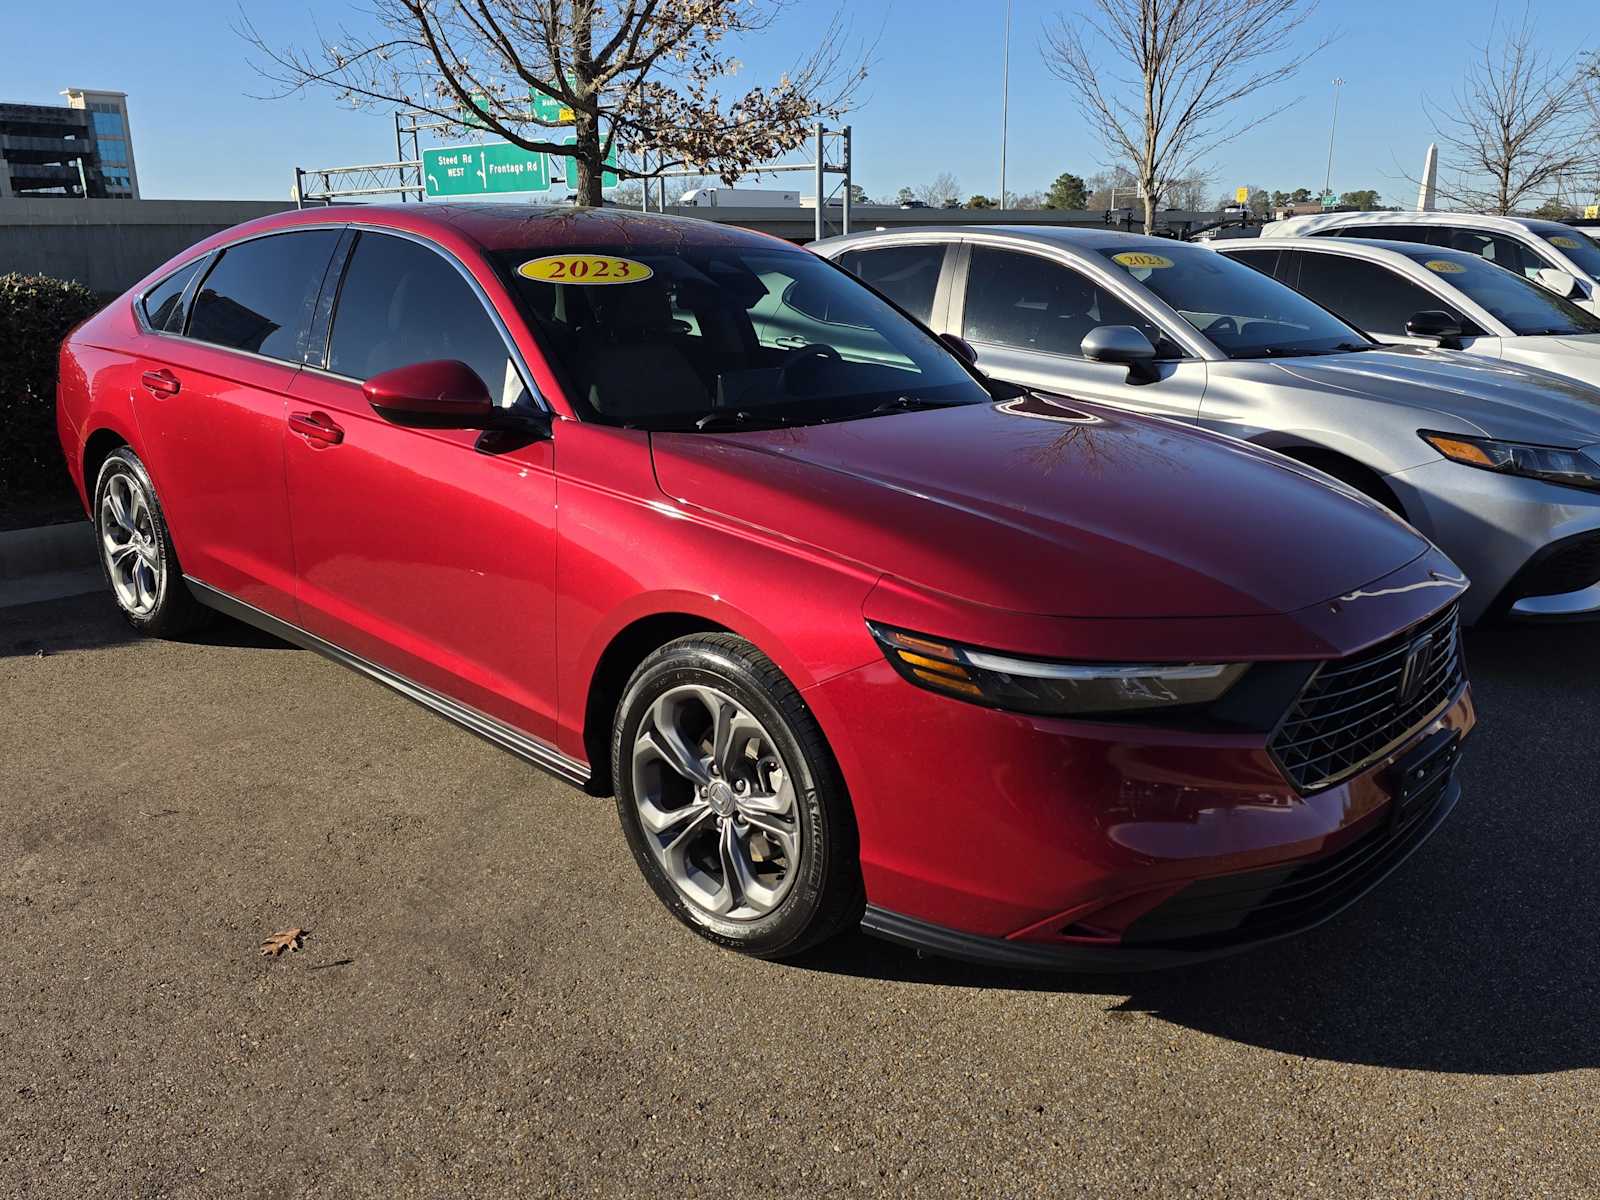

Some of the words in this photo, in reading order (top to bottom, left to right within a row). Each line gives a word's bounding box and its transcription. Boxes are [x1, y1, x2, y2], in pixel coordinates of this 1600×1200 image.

[438, 155, 458, 166] Steed
[462, 154, 472, 164] Rd
[447, 167, 465, 177] WEST
[489, 162, 524, 175] Frontage
[527, 161, 538, 171] Rd
[548, 260, 630, 279] 2023
